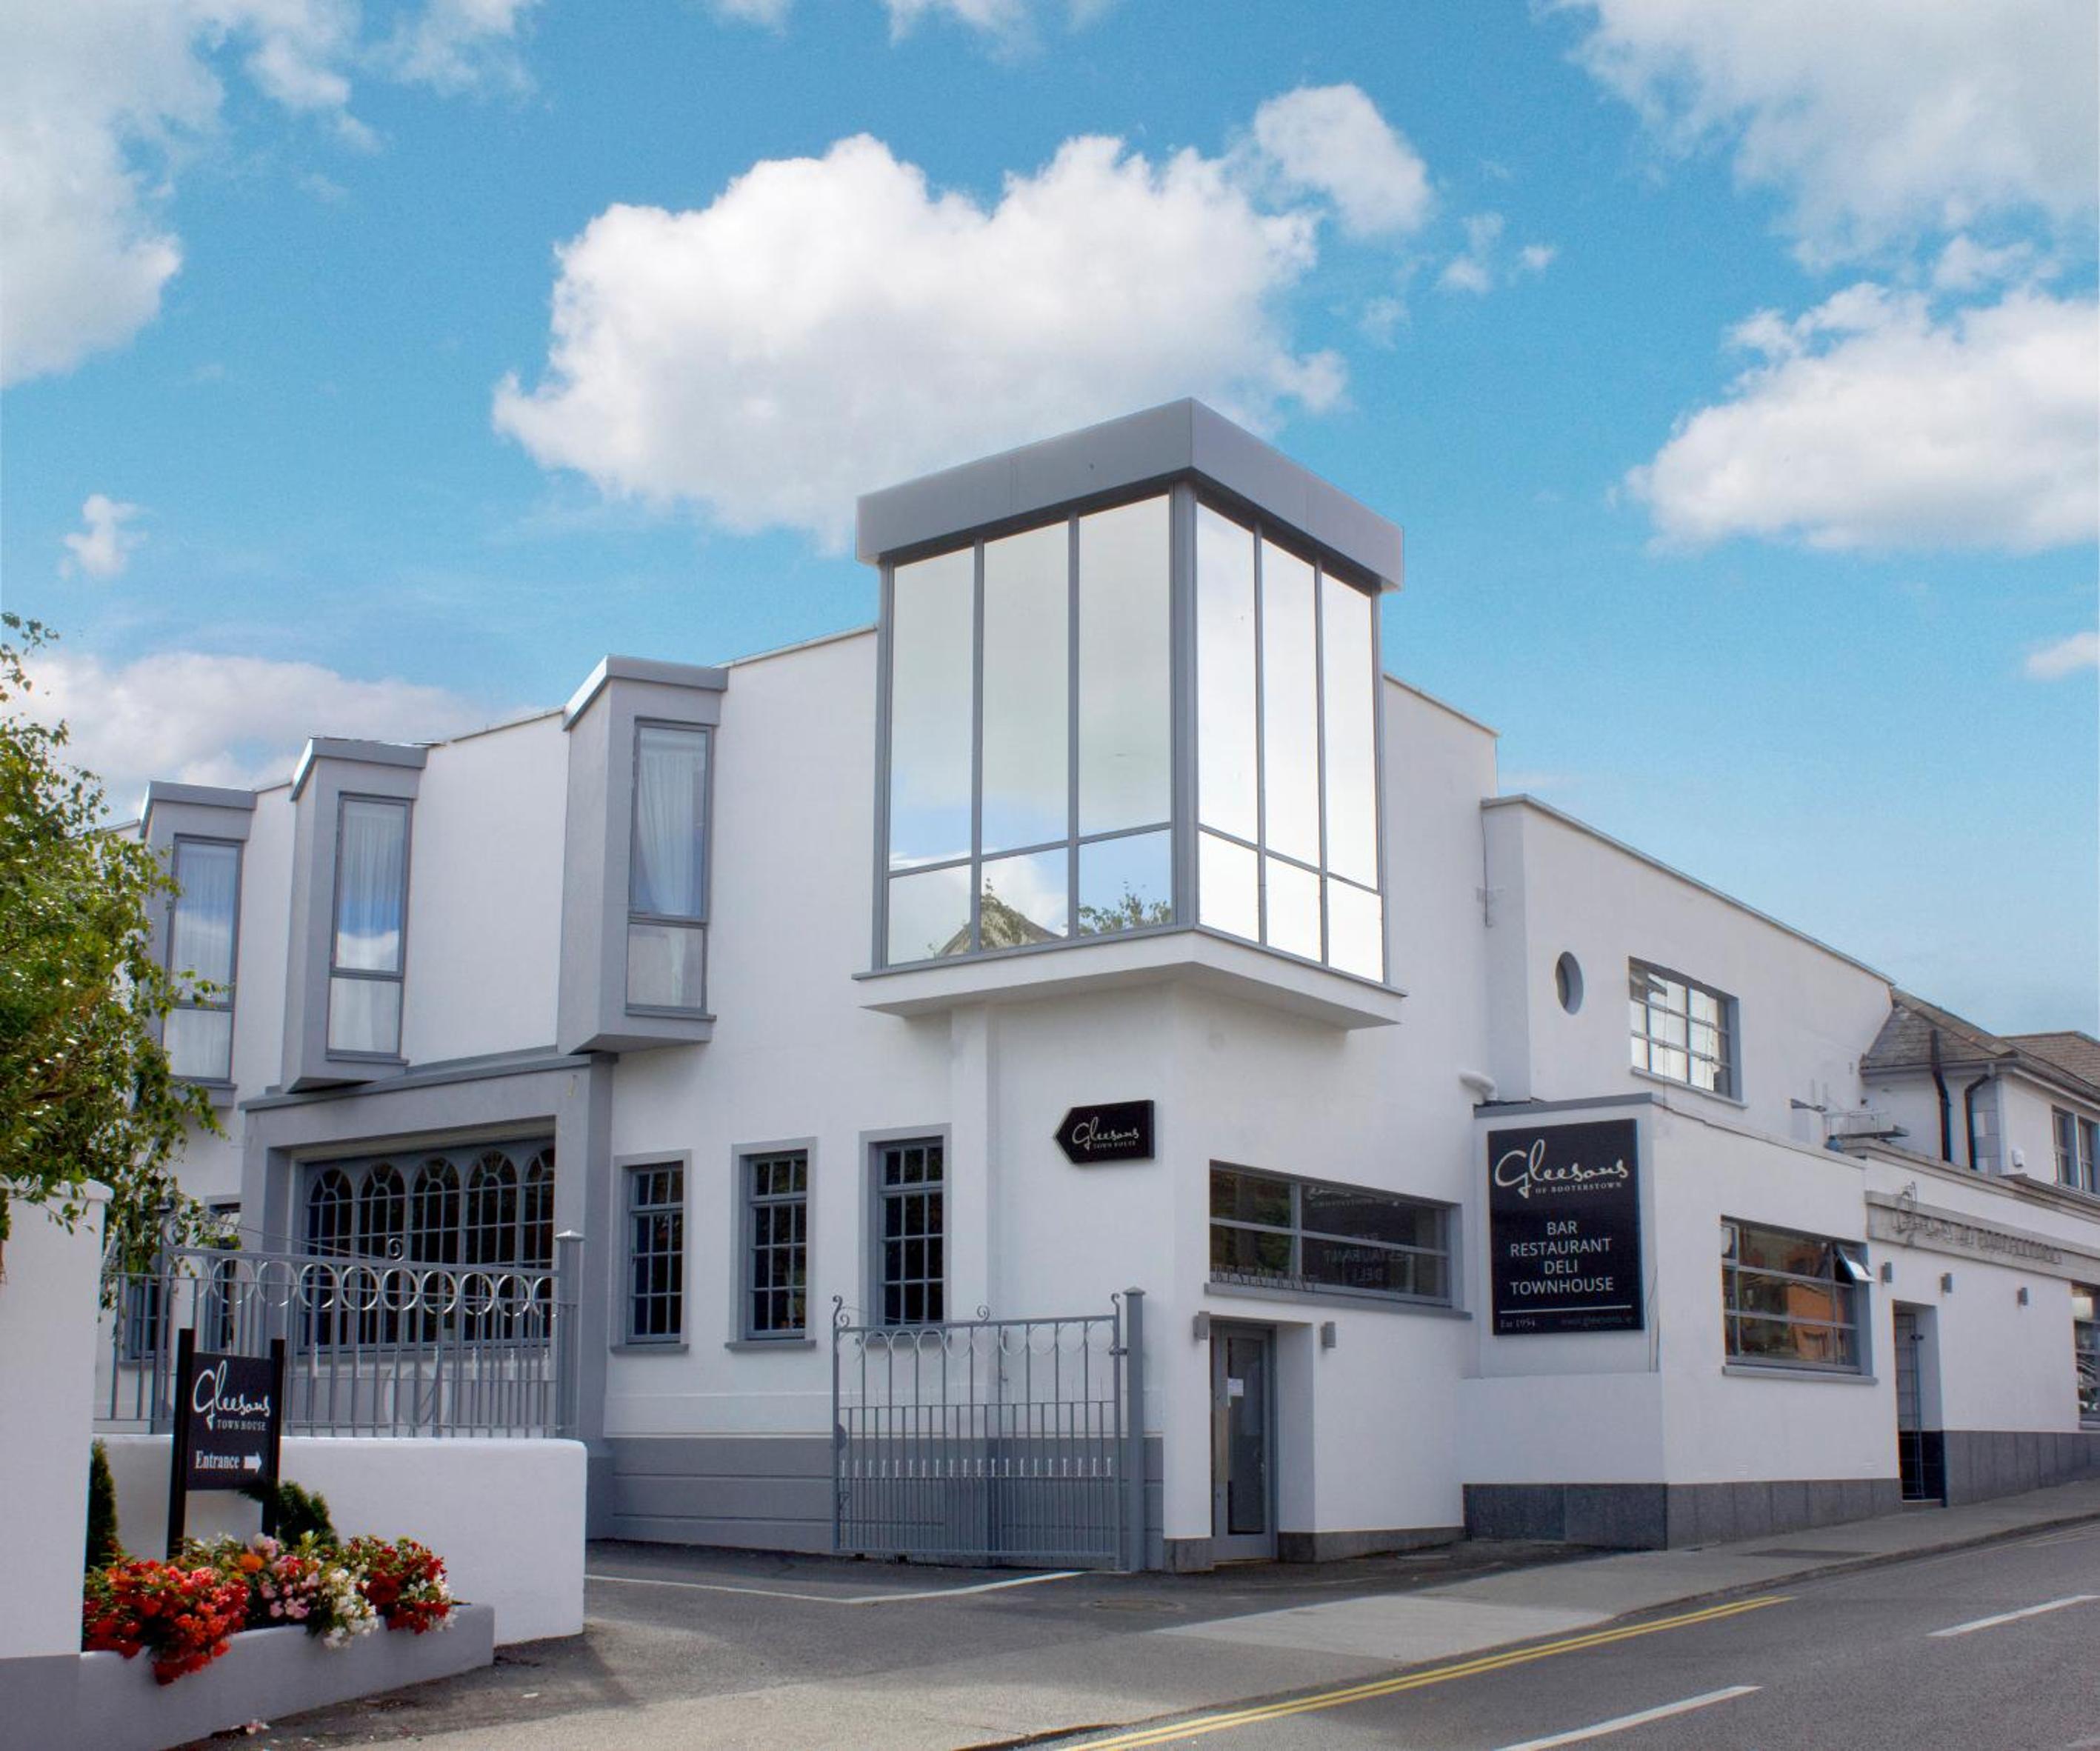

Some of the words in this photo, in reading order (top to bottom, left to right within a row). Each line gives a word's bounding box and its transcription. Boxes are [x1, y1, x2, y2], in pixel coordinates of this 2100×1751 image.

[1495, 1138, 1629, 1198] Gleesons
[1547, 1221, 1578, 1236] BAR
[1510, 1238, 1612, 1258] RESTAURANT
[1544, 1258, 1579, 1275] DELI
[1510, 1277, 1613, 1295] TOWNHOUSE
[193, 1360, 270, 1430] Gleesons
[195, 1450, 241, 1470] Entrance
